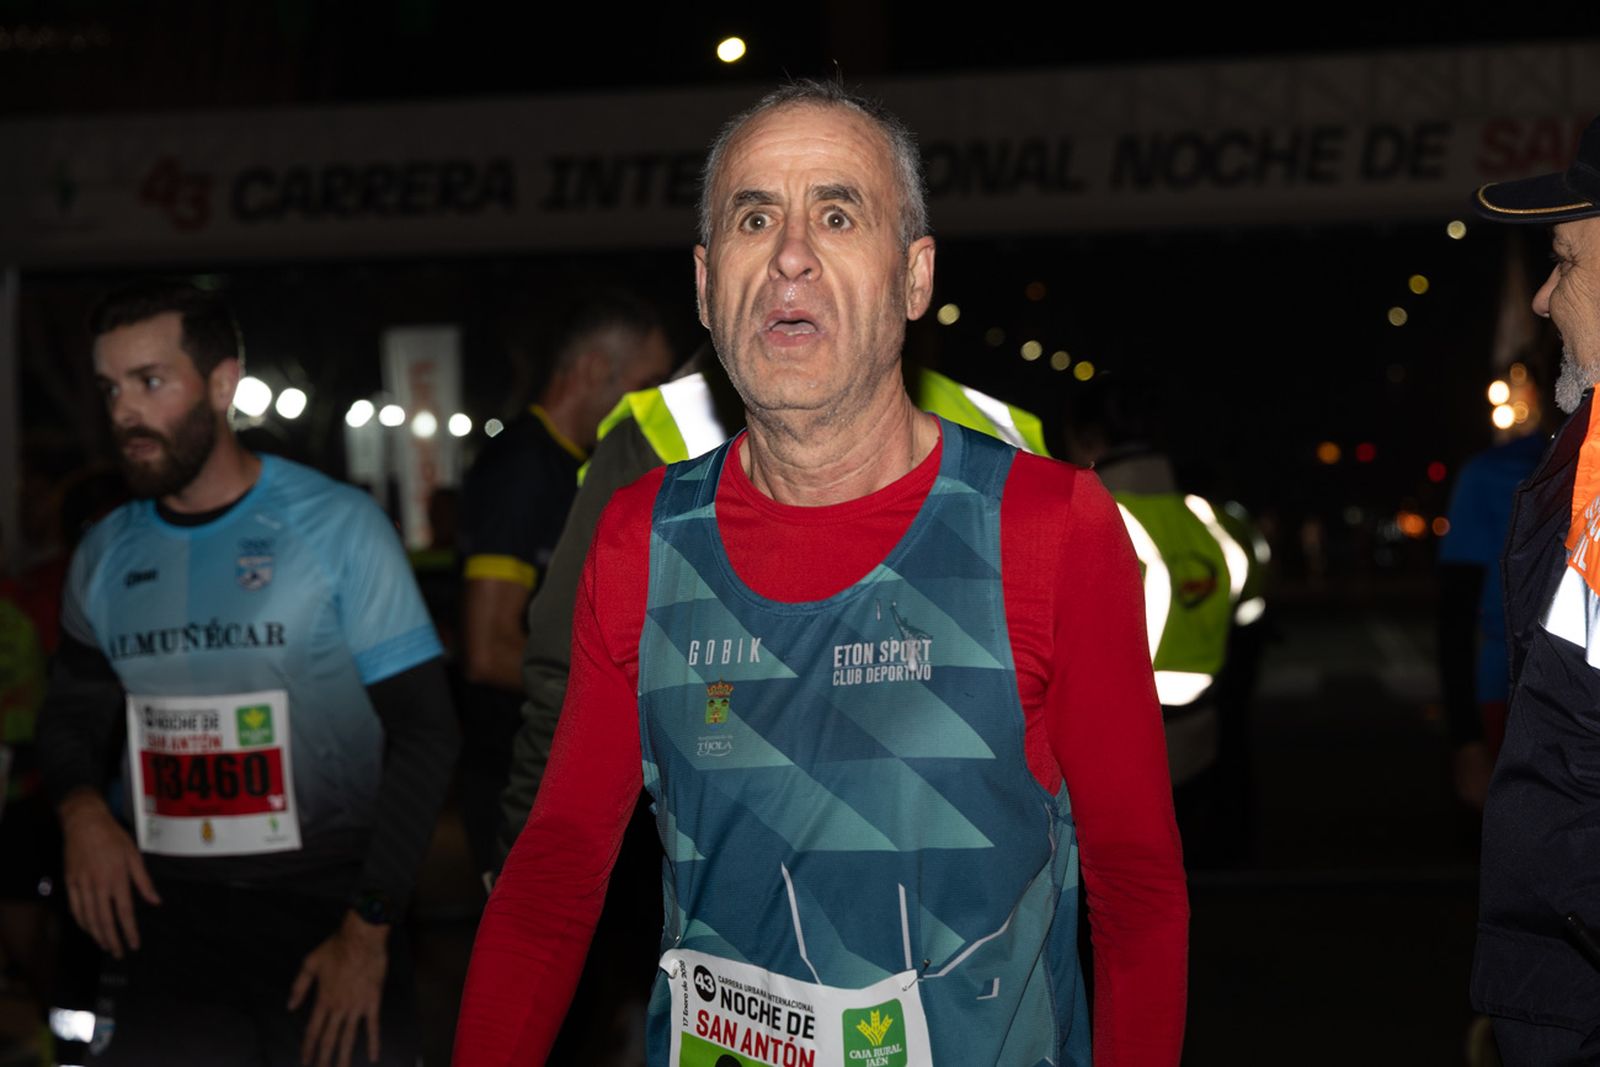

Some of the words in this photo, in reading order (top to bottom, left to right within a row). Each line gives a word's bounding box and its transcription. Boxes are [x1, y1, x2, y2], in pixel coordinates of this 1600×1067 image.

[139, 155, 214, 231] 43
[230, 157, 515, 222] CARRERA
[1110, 122, 1345, 191] NOCHE
[1360, 120, 1453, 178] DE
[688, 637, 763, 667] GOBIK
[833, 641, 874, 668] ETON
[879, 638, 932, 664] SPORT
[832, 670, 862, 686] CLUB
[865, 664, 932, 683] DEPORTIVO
[154, 753, 271, 800] 13460
[695, 972, 715, 994] 43
[718, 975, 743, 991] CARRERA
[744, 984, 768, 999] URBANA
[682, 1016, 689, 1027] 17
[720, 986, 782, 1031] NOCHE
[786, 1010, 815, 1040] DE
[696, 1009, 738, 1049] SAN
[740, 1026, 816, 1067] ANTÓN
[849, 1049, 872, 1059] CAJA
[873, 1043, 903, 1058] RURAL
